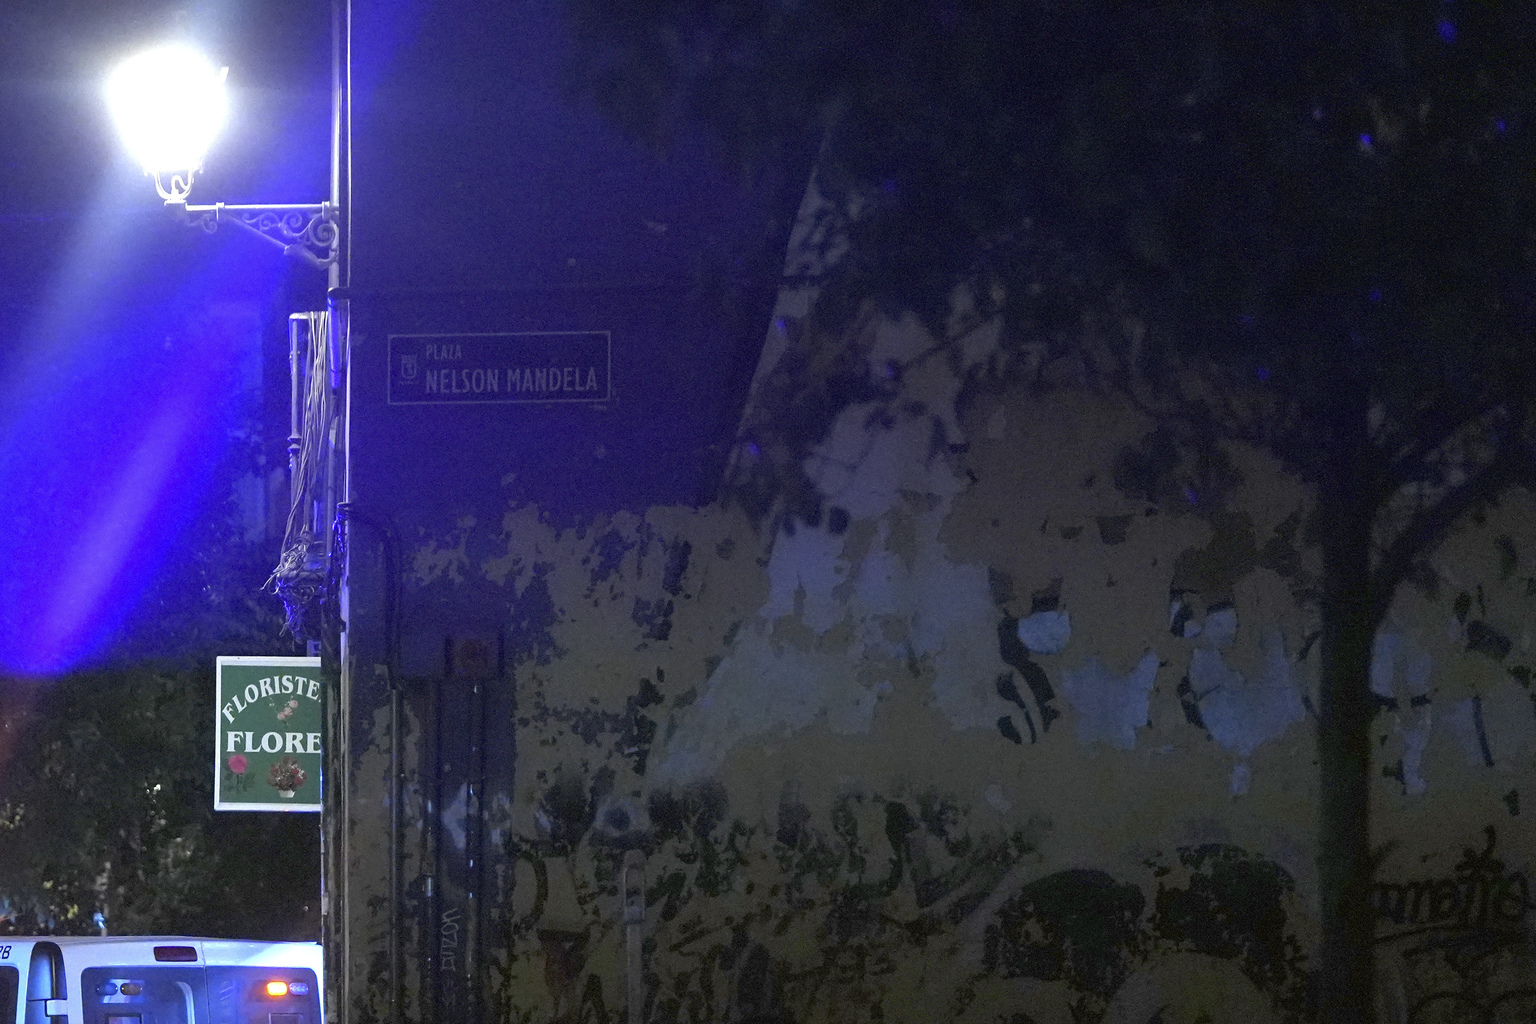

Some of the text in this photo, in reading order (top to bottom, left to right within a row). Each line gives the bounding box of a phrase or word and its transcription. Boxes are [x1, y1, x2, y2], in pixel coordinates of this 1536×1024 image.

[426, 344, 463, 360] PLAZA
[426, 366, 598, 394] NELSON MANDELA
